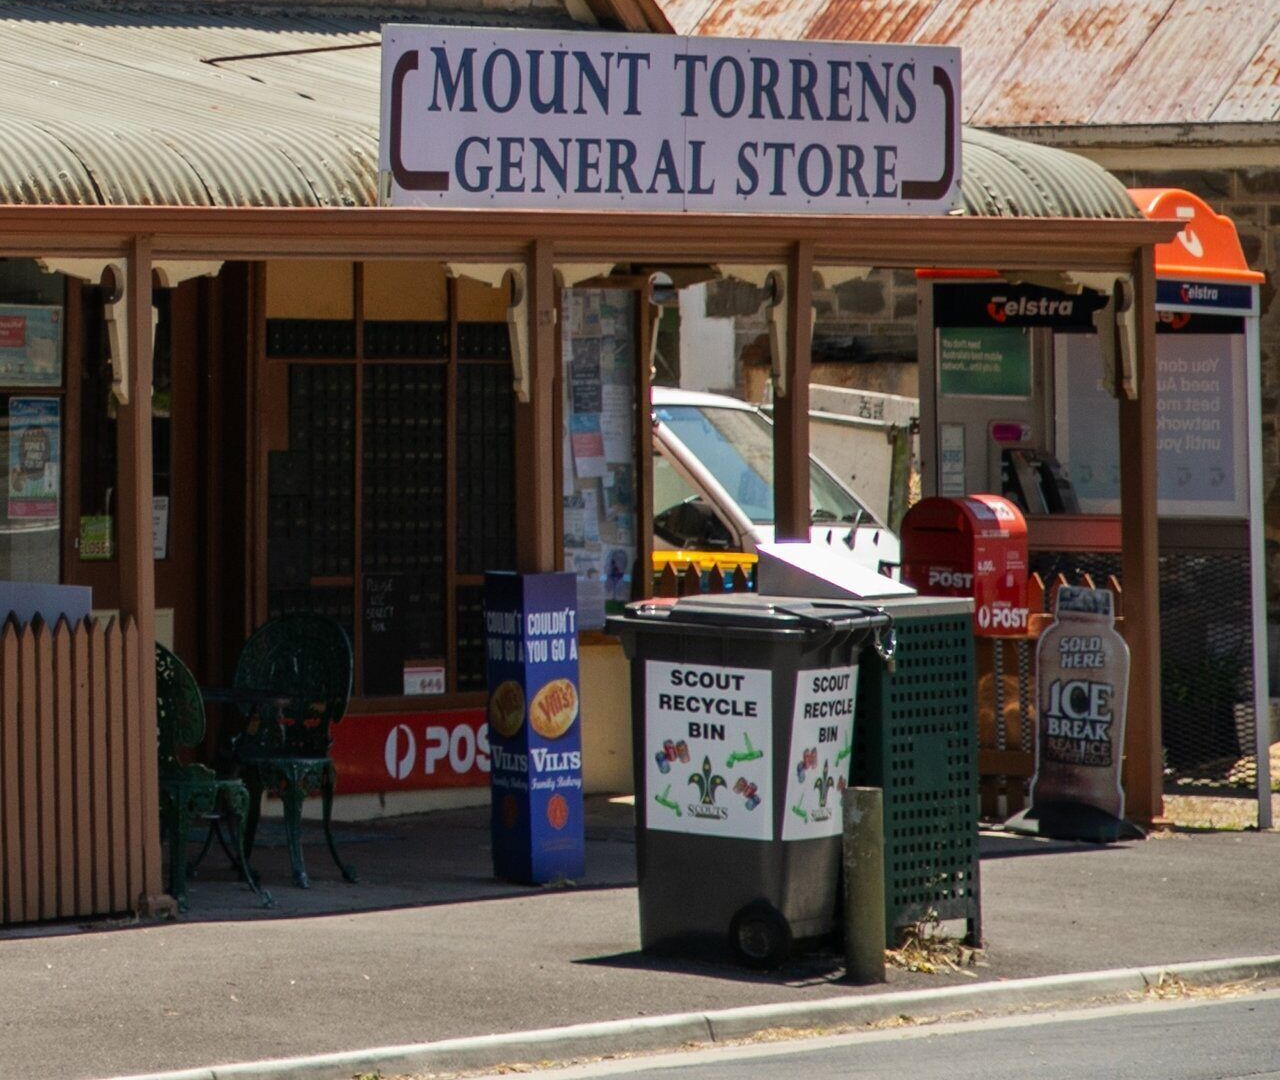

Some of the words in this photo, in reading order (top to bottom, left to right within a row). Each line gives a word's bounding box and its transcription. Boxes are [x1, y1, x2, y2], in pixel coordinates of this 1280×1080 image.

[427, 47, 651, 116] MOUNT
[674, 52, 917, 125] TORRENS
[455, 136, 716, 196] GENERAL
[736, 141, 899, 200] STORE
[1179, 284, 1219, 303] Telstra
[987, 296, 1073, 322] Telstra
[929, 572, 973, 588] POST
[527, 607, 575, 636] COULDN'T
[992, 607, 1029, 628] POST
[527, 639, 548, 663] YOU
[551, 639, 566, 662] GO
[569, 638, 578, 661] A
[1060, 636, 1102, 653] SOLD
[1061, 653, 1104, 668] HERE
[670, 669, 745, 691] SCOUT
[813, 674, 850, 693] SCOUT
[658, 693, 758, 717] RECYCLE
[804, 698, 853, 719] RECYCLE
[1047, 680, 1113, 722] ICE
[688, 722, 725, 741] BIN
[818, 726, 838, 743] BIN
[1047, 718, 1109, 741] BREAK
[425, 724, 491, 774] POS
